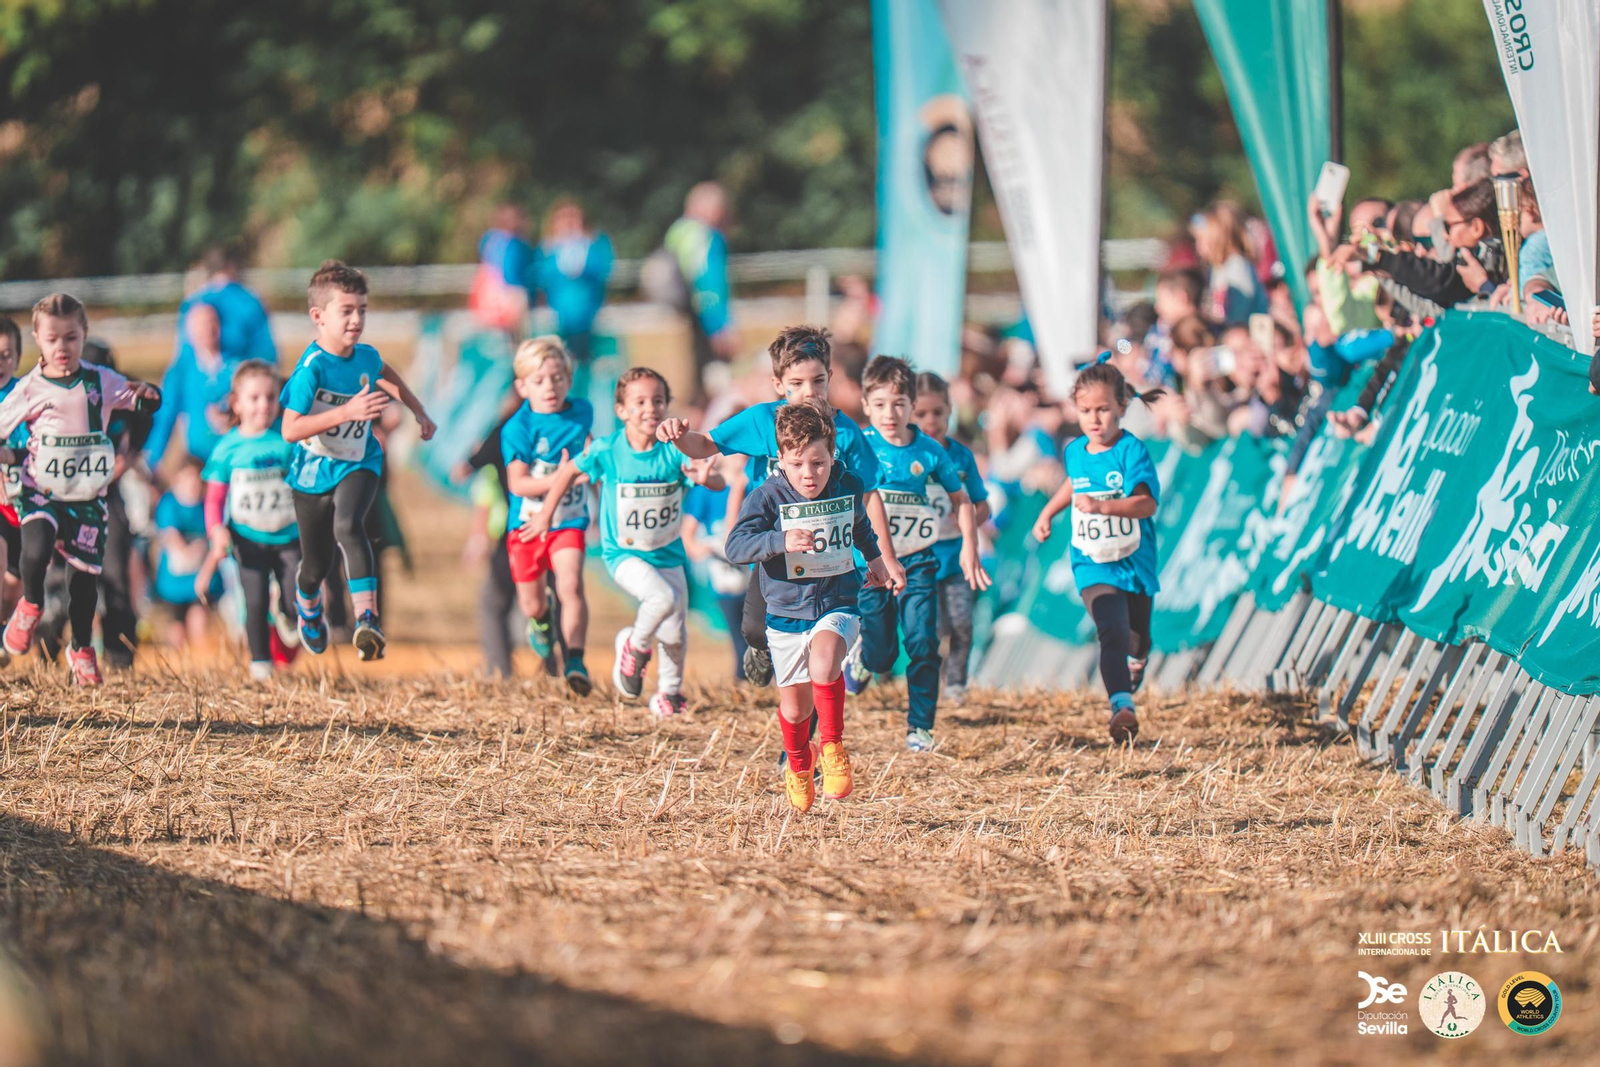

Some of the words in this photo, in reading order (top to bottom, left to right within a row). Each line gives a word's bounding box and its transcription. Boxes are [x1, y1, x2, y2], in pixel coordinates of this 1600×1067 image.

[326, 420, 366, 439] 578
[45, 455, 109, 479] 4644
[626, 501, 679, 530] 4695
[889, 516, 934, 538] 576
[802, 523, 852, 554] 646
[1078, 516, 1133, 541] 4610
